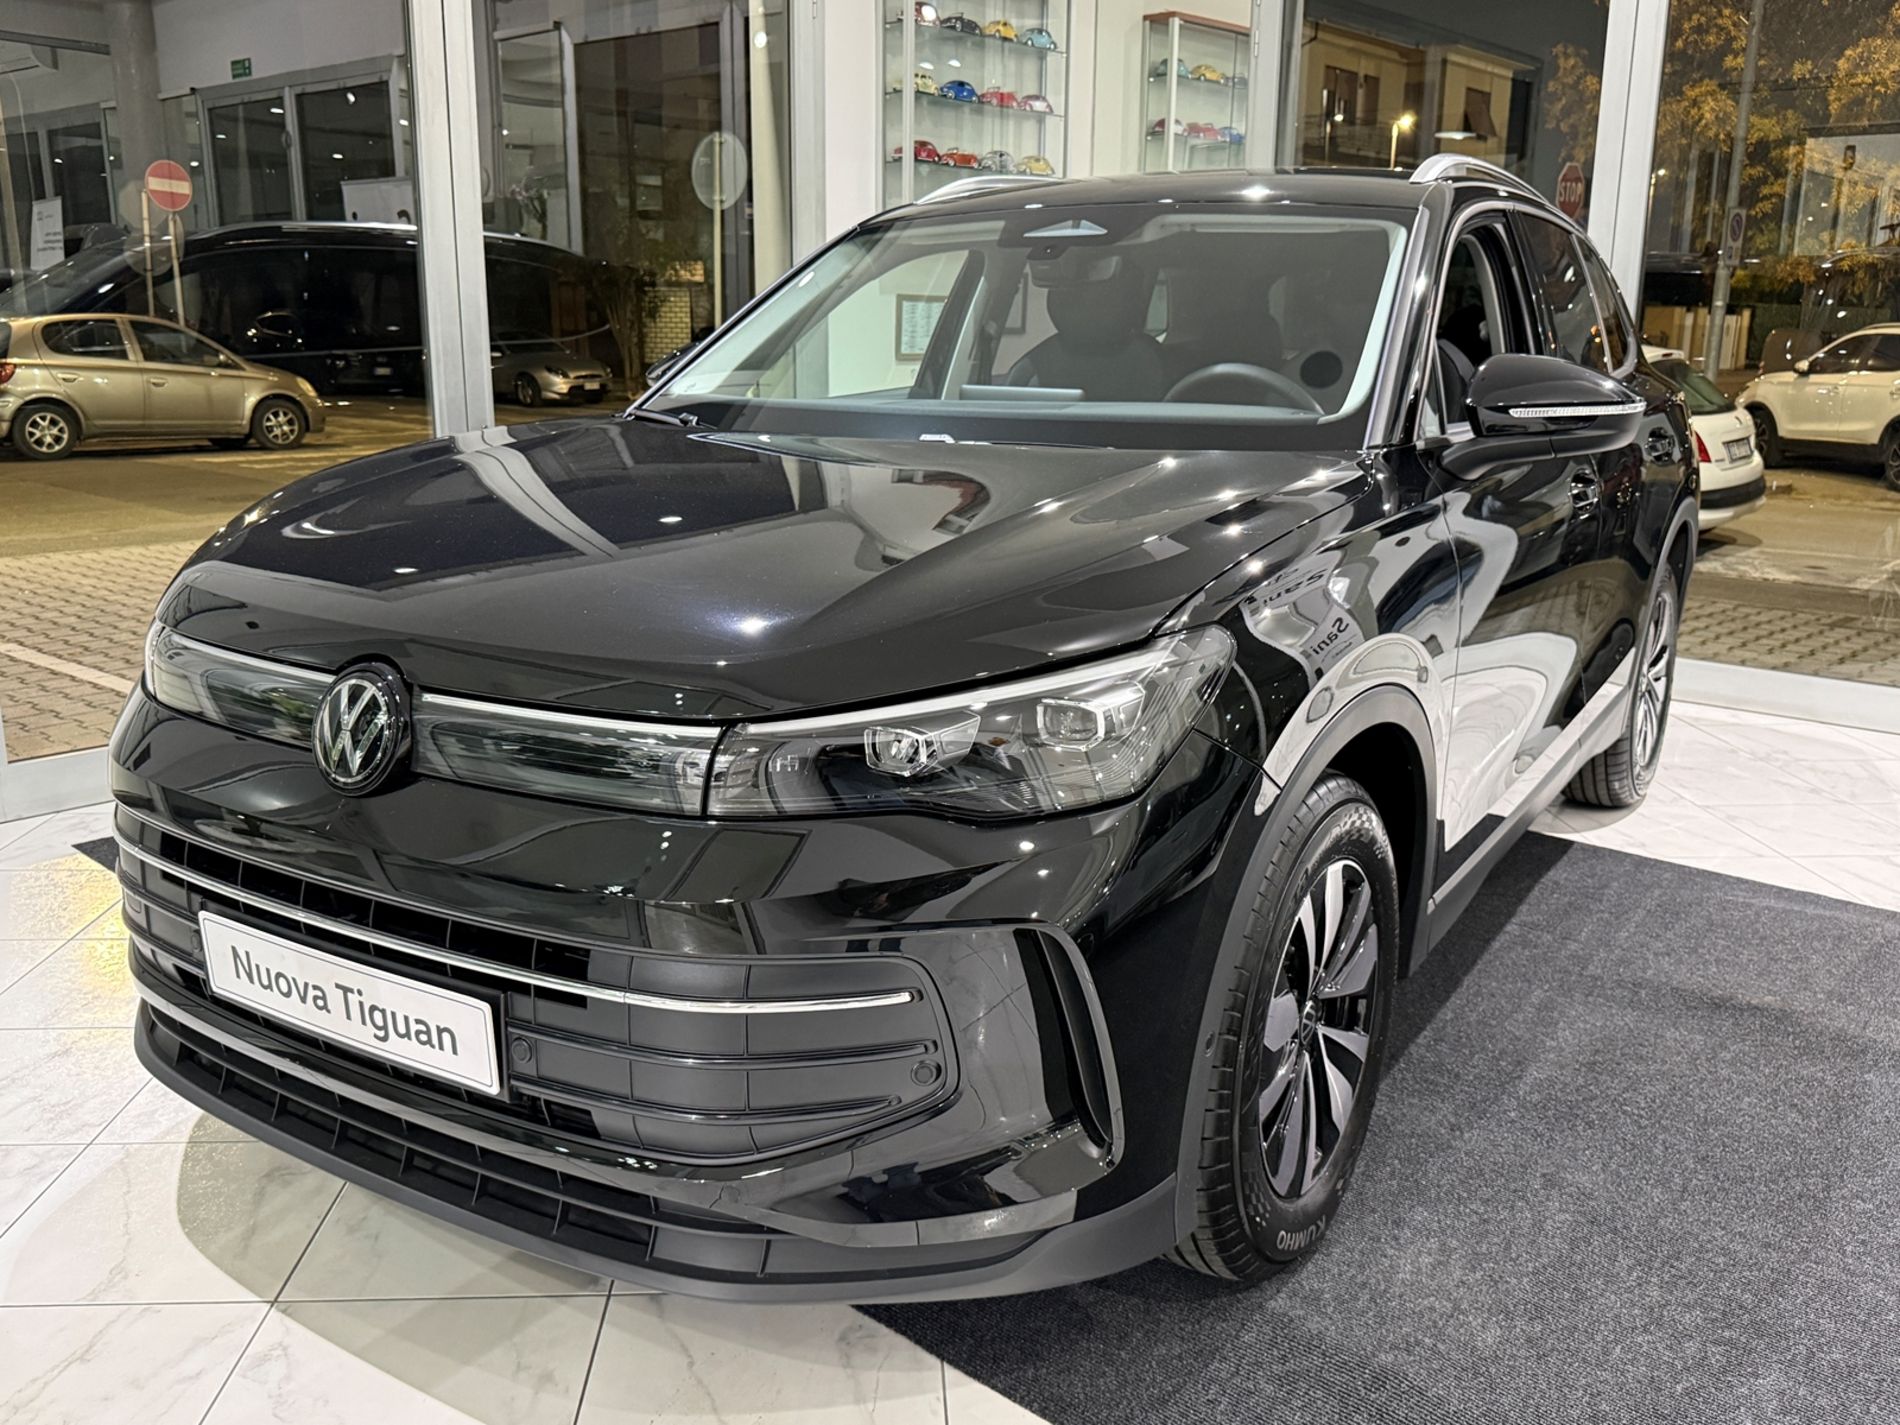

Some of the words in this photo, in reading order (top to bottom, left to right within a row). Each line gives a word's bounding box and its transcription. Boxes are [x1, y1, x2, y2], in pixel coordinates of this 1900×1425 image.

[1560, 181, 1583, 203] STOP
[231, 945, 331, 1014] Nuova
[334, 982, 458, 1056] Tiguan
[1276, 1214, 1326, 1251] KUMHO
